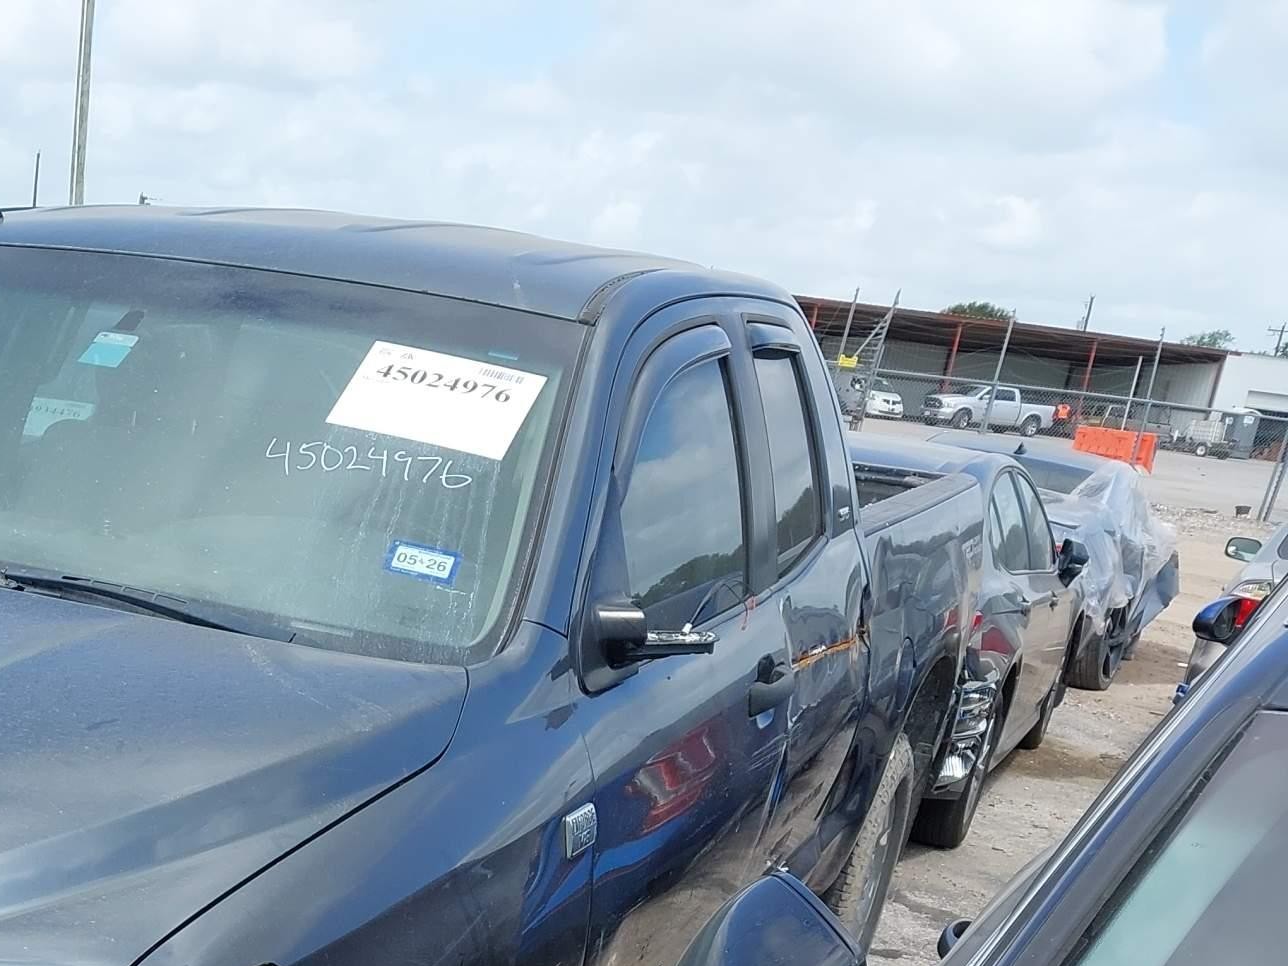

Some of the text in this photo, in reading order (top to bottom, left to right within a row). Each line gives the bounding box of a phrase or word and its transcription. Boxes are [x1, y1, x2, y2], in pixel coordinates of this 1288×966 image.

[376, 364, 512, 403] 45024976
[265, 438, 472, 488] 45024976
[396, 552, 448, 572] 05 26
